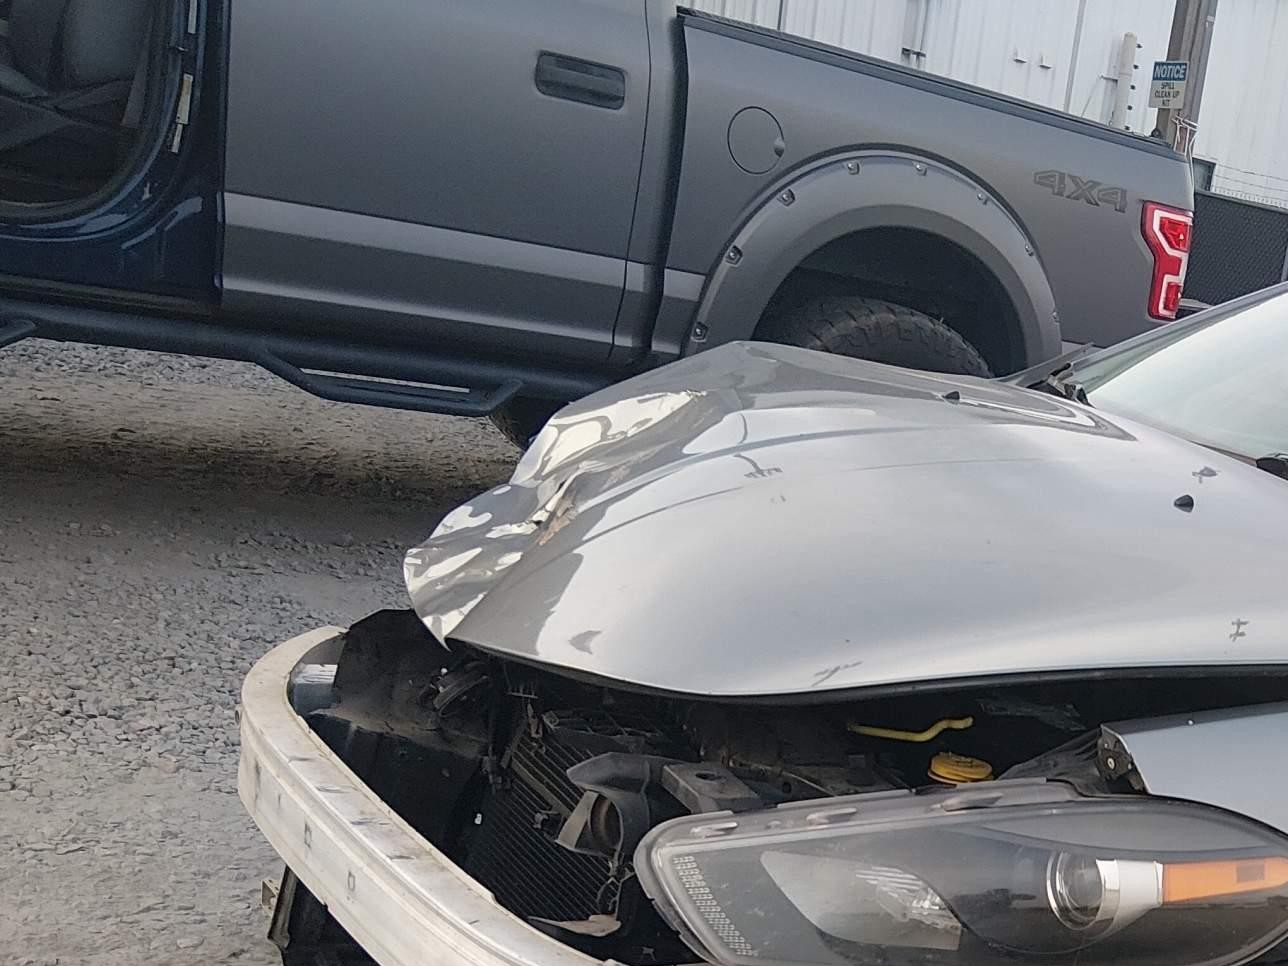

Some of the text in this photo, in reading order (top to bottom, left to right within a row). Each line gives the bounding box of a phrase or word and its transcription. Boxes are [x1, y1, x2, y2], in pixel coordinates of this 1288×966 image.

[1154, 65, 1186, 79] NOTICE
[1160, 82, 1175, 90] SPILL
[1154, 90, 1180, 99] CLEAN UP
[1032, 169, 1127, 213] 4X4
